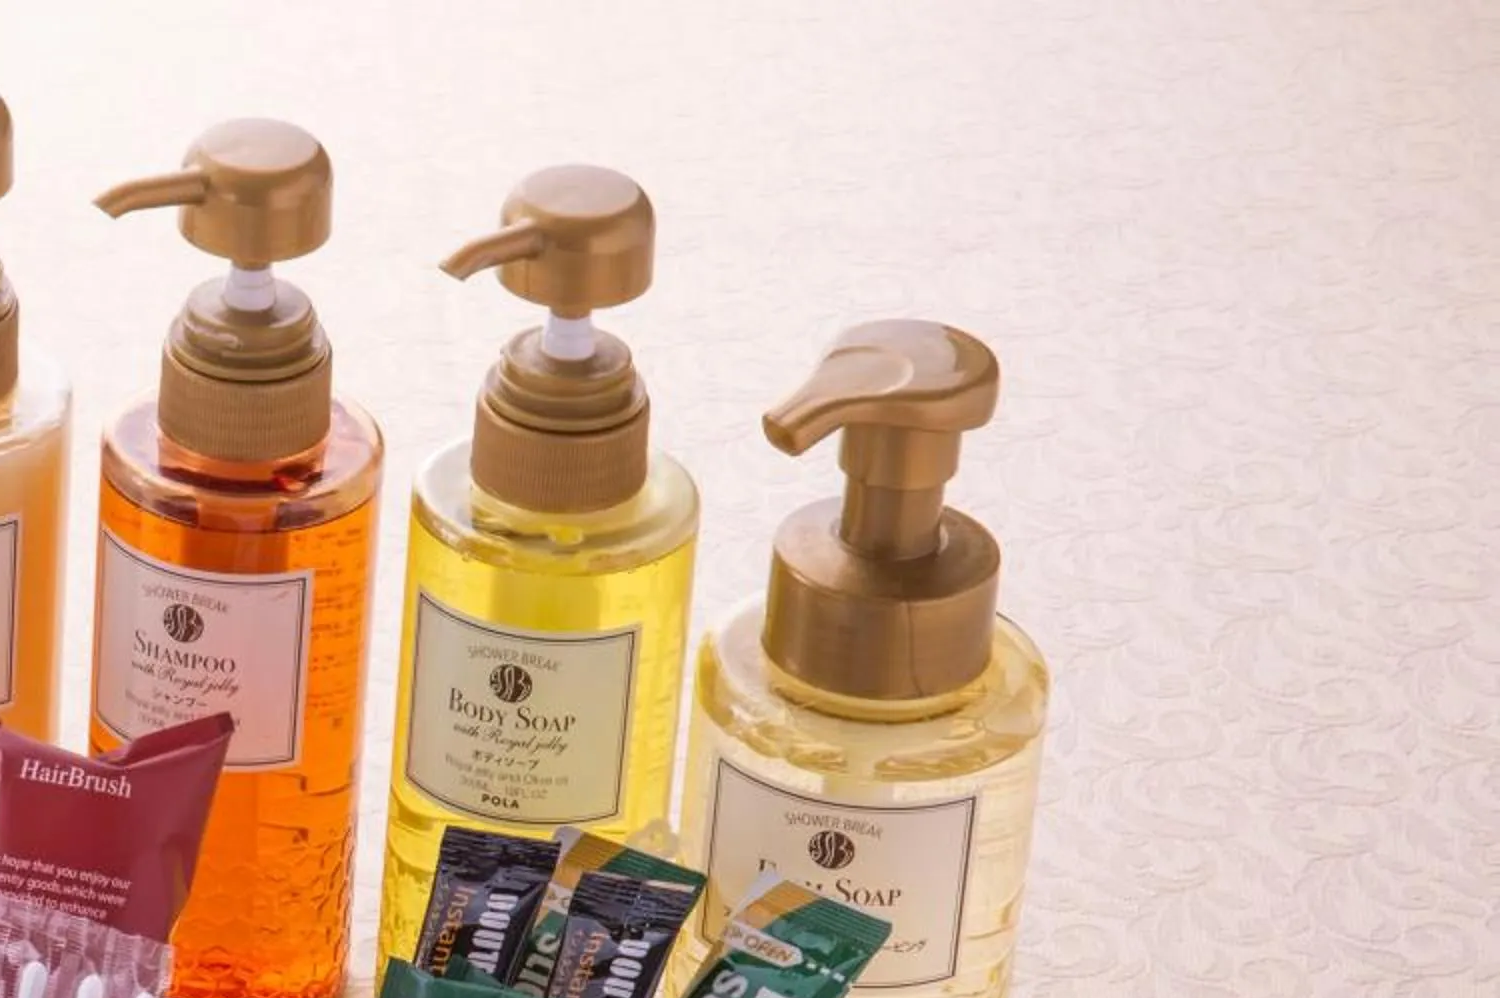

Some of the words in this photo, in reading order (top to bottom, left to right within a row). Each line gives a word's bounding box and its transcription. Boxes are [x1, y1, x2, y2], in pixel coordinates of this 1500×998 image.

[141, 584, 189, 602] SHOWER
[133, 629, 236, 673] SHAMPOO
[467, 645, 519, 662] SHOWER
[521, 652, 561, 672] BREAK
[131, 660, 155, 674] with
[449, 687, 508, 727] BODY
[515, 705, 576, 733] SOAP
[453, 723, 480, 737] with
[482, 728, 535, 752] Royal
[19, 758, 133, 799] HairBrush
[482, 793, 520, 809] POLA
[784, 811, 841, 829] SHOWER
[843, 819, 884, 839] BREAK
[835, 878, 902, 907] SOAP
